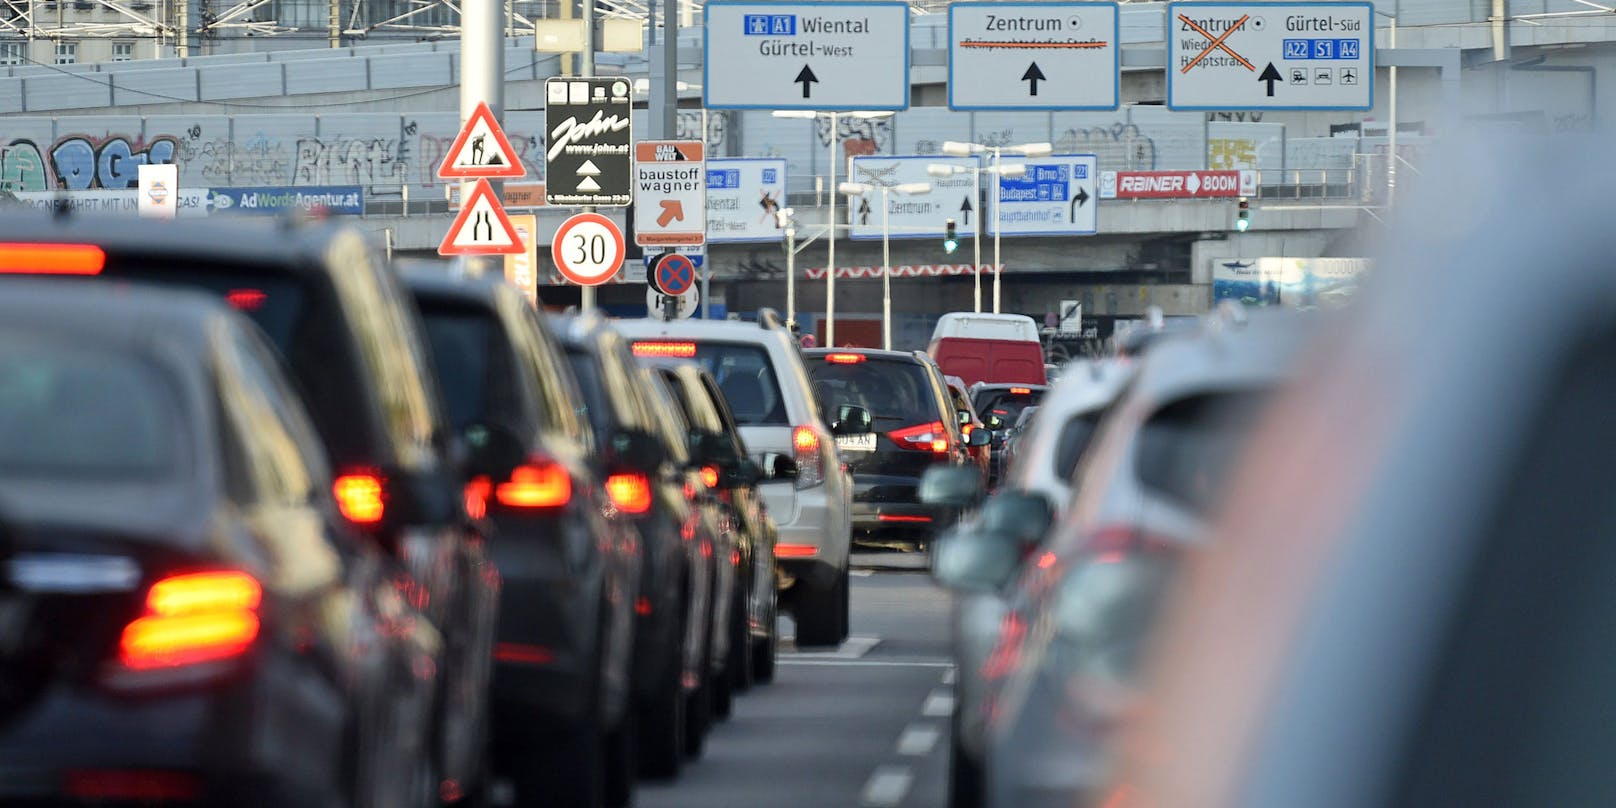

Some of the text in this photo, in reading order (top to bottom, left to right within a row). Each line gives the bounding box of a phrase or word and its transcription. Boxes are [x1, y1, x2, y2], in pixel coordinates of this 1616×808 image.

[774, 16, 870, 33] A1 Wiental
[986, 15, 1062, 31] Zentrum
[1286, 16, 1361, 31] Gürtel-Süd
[760, 40, 854, 56] Gürtel-West
[1181, 39, 1226, 50] Wied
[1287, 42, 1357, 57] A22 S1 A4
[1180, 56, 1250, 69] Huptstra
[547, 109, 629, 163] John
[565, 143, 629, 155] www.john.at
[656, 145, 675, 153] BAU
[655, 152, 677, 161] WELT
[639, 168, 699, 180] baustoff
[640, 181, 699, 194] wagner
[1119, 175, 1237, 191] RAINER 800M
[239, 192, 359, 210] AdWordsAgentur.at
[1000, 187, 1037, 201] Budapest
[1000, 211, 1051, 223] auptbahnhof
[573, 235, 606, 264] 30
